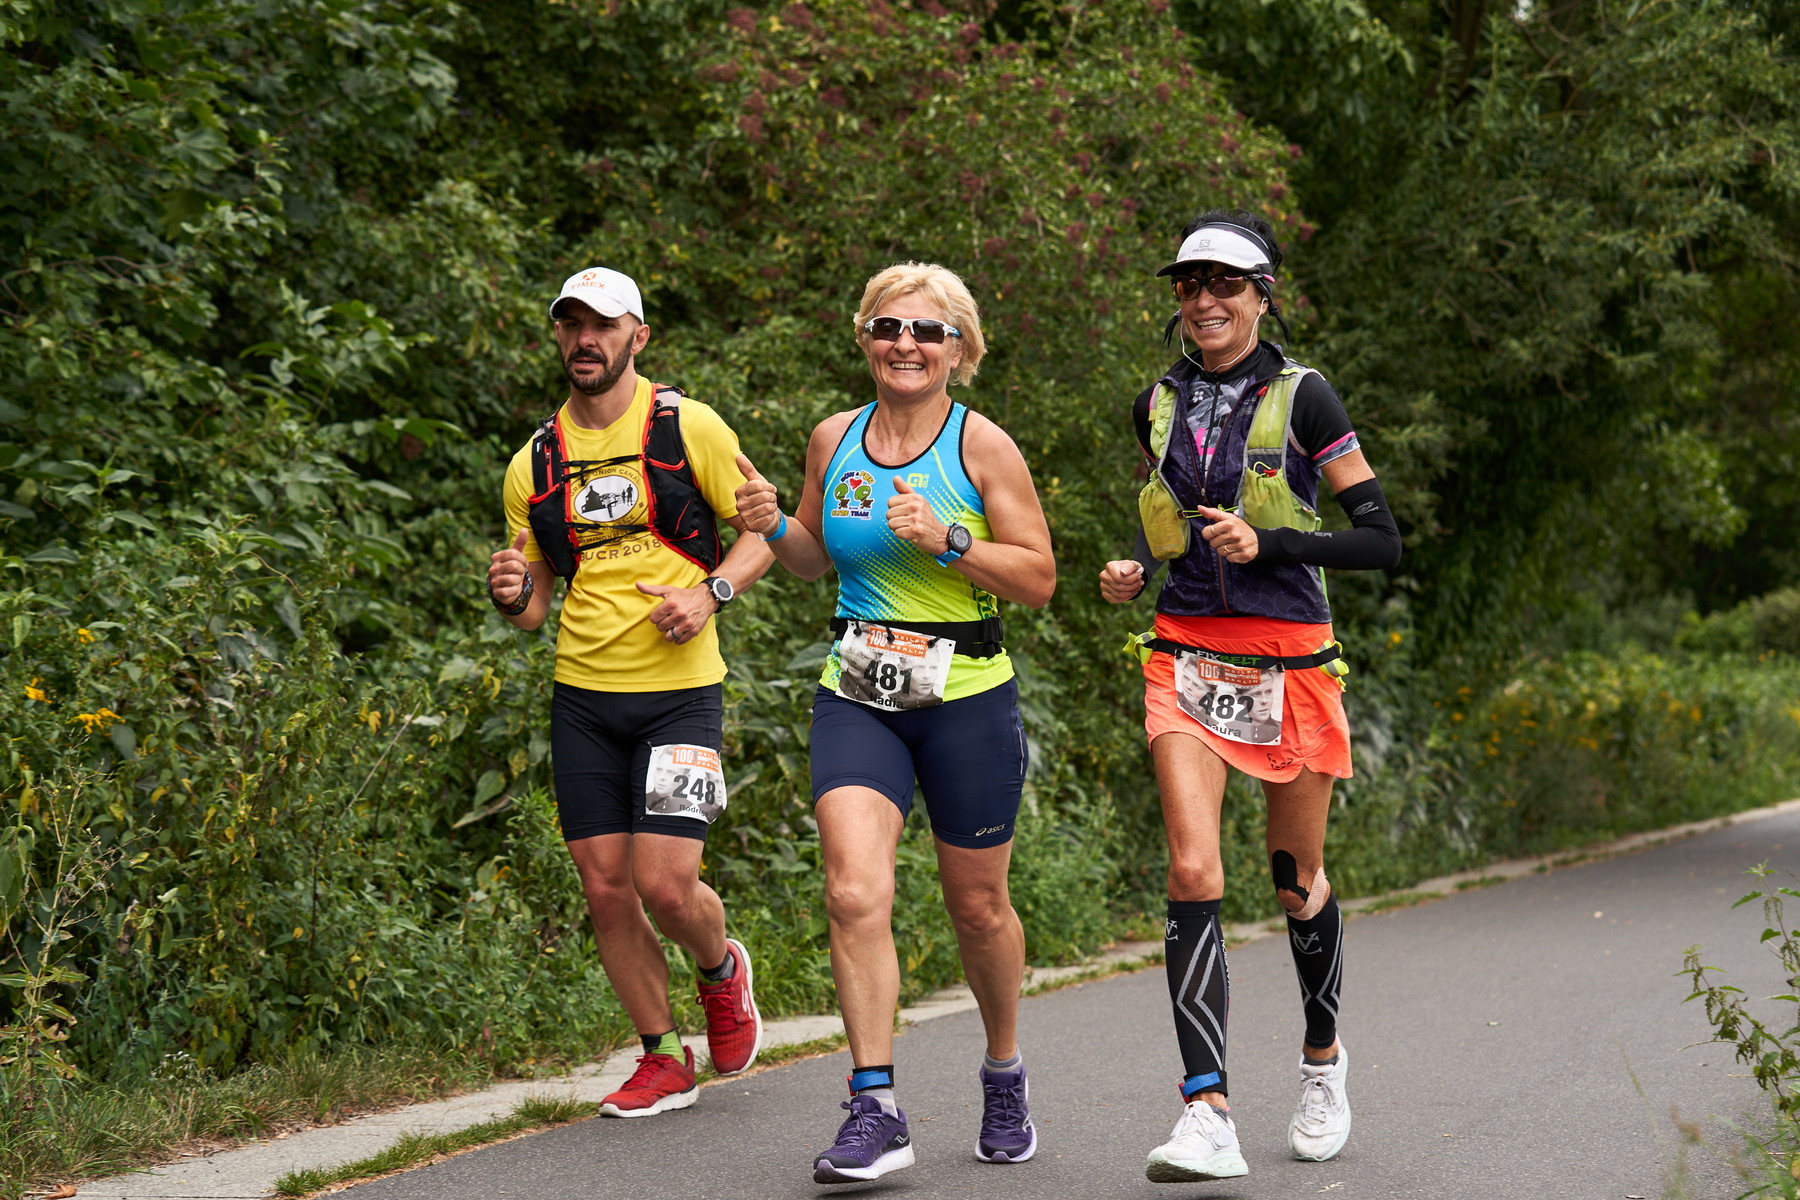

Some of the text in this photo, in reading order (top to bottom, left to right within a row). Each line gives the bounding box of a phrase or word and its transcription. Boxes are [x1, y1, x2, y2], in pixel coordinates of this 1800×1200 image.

[571, 281, 605, 290] TIMEX
[592, 468, 617, 477] UNION
[618, 468, 641, 485] CANAL
[860, 471, 875, 484] FUN
[622, 538, 662, 556] 2018
[893, 634, 927, 645] MEILEN
[890, 644, 925, 655] BERLIN
[863, 660, 912, 695] 481
[869, 692, 904, 708] Nadia
[1198, 692, 1254, 723] 482
[1205, 719, 1242, 737] Laura
[672, 775, 716, 806] 248
[986, 823, 1006, 834] asics
